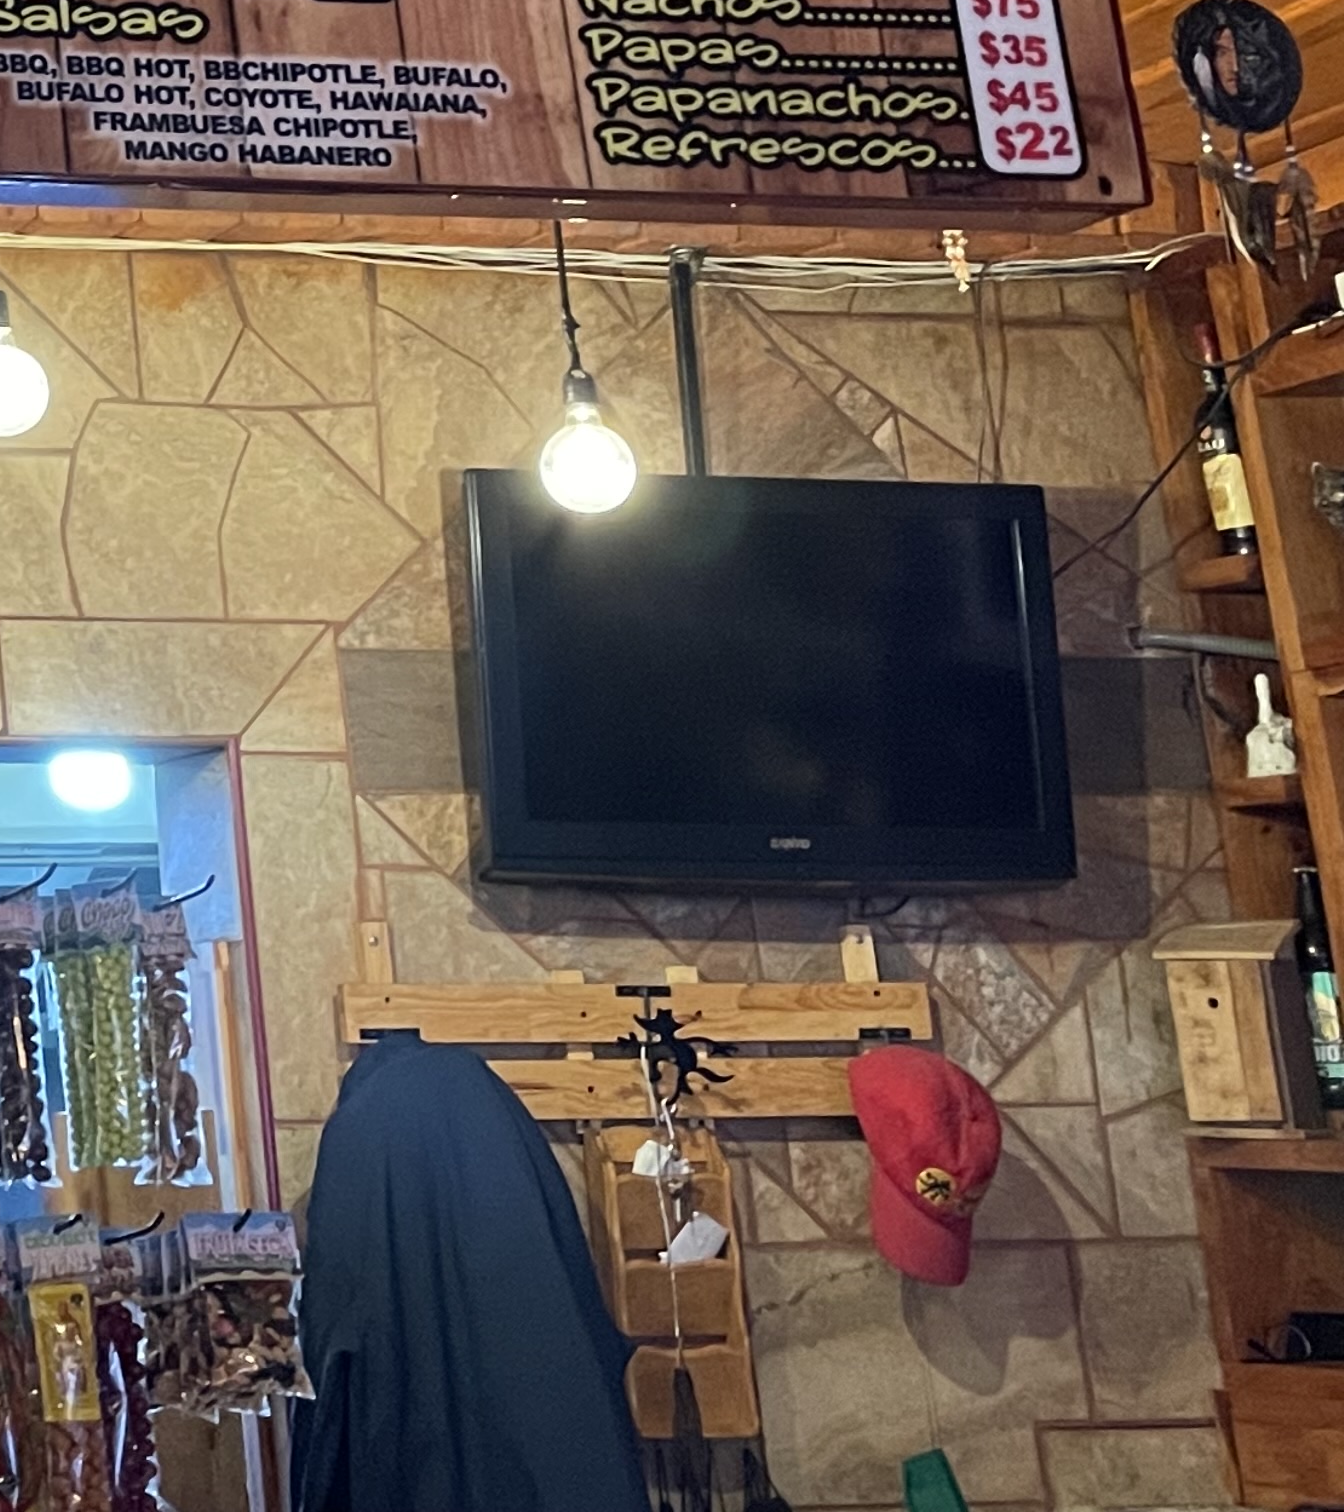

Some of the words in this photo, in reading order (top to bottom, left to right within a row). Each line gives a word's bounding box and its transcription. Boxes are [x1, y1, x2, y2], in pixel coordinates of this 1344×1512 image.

[980, 33, 1048, 67] $35
[65, 55, 126, 78] BBQ
[133, 57, 196, 85] HOT,
[203, 60, 386, 90] BBCHIPOTLE,
[393, 65, 507, 94] BUFALO,
[16, 80, 125, 104] BUFALO
[133, 84, 196, 110] HOT,
[204, 86, 322, 115] COYOTE,
[329, 90, 487, 119] HAWAIANA,
[988, 79, 1058, 113] $45
[93, 110, 266, 137] FRAMBUESA
[273, 116, 418, 146] CHIPOTLE,
[996, 121, 1074, 161] $22
[124, 139, 229, 163] MANGO
[237, 143, 392, 168] HABANERO
